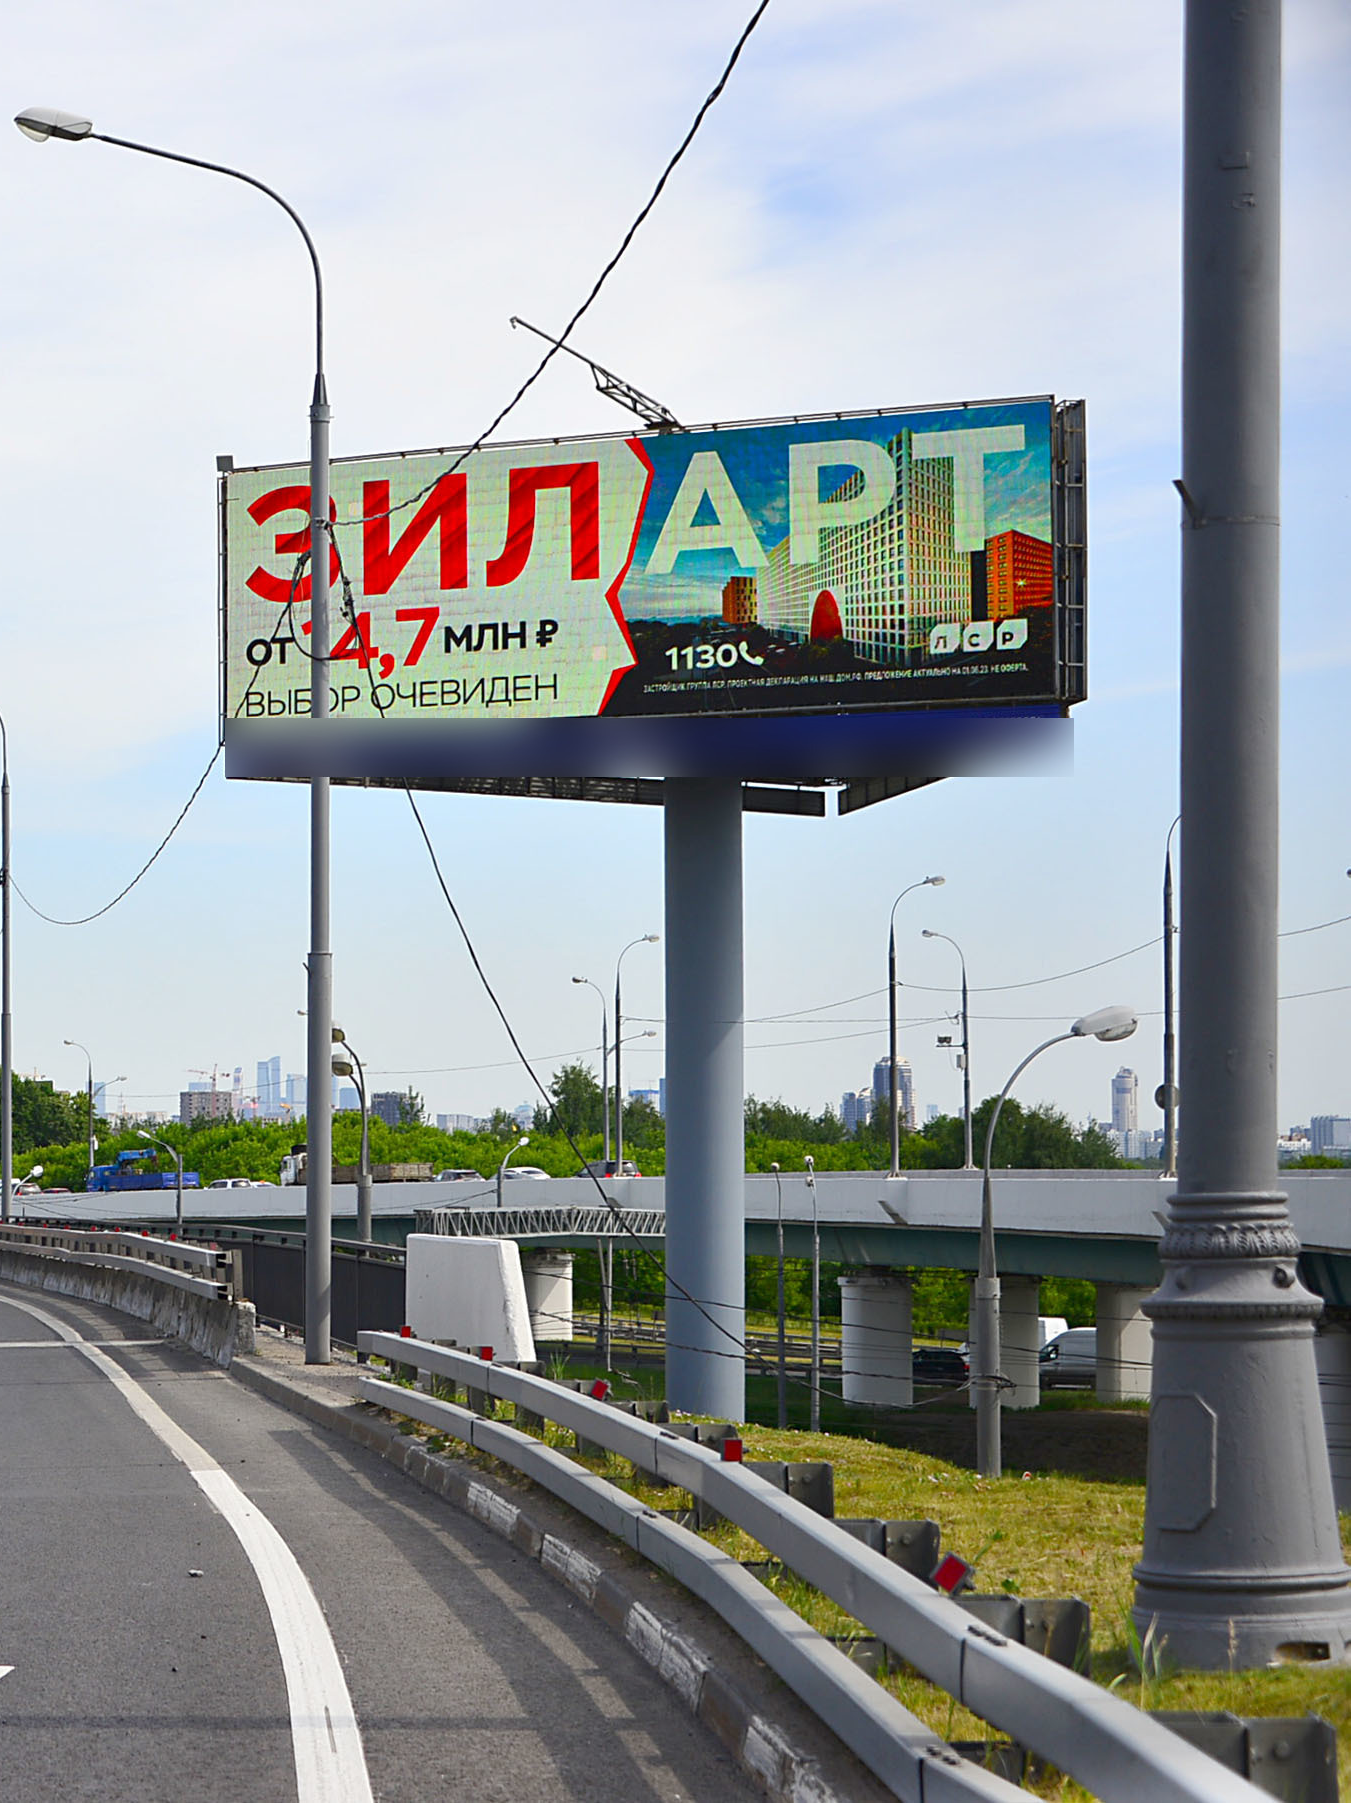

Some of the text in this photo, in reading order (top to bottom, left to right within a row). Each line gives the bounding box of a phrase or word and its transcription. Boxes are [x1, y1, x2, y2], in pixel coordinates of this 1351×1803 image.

[246, 637, 295, 667] ОТ
[301, 606, 440, 679] 4,7
[443, 621, 527, 654] МЛН
[664, 645, 739, 671] 1130
[370, 674, 559, 711] ОЧЕВИДЕН
